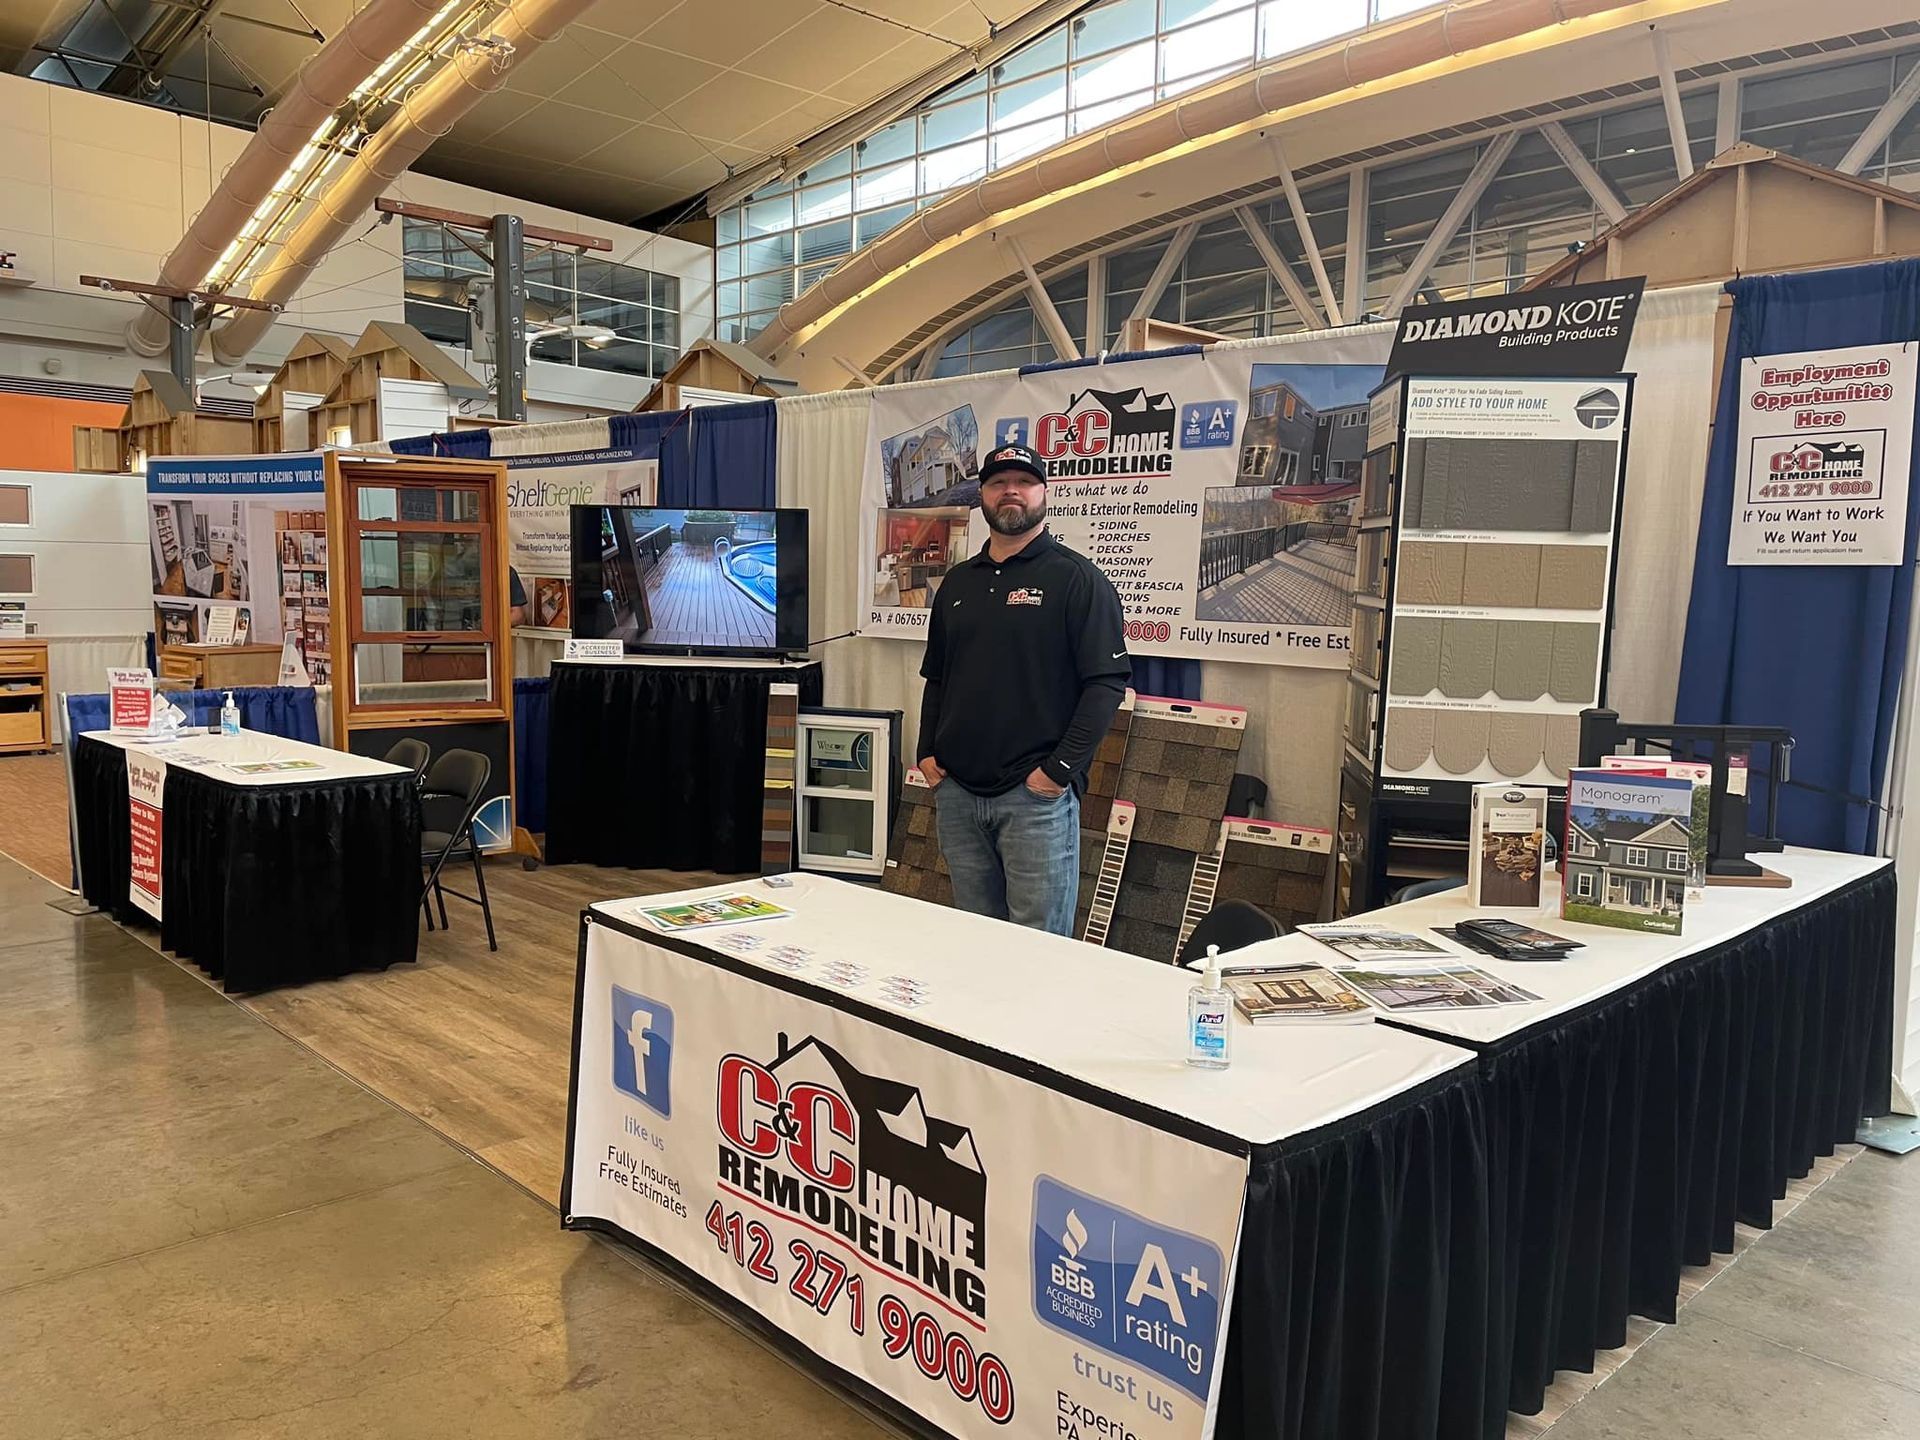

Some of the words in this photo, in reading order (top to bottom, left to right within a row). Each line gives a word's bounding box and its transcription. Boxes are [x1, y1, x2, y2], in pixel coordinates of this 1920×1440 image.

[1402, 305, 1552, 343] DIAMOND
[1556, 295, 1625, 326] KOTE
[1499, 332, 1551, 348] Building
[1555, 325, 1618, 342] Products
[1761, 359, 1890, 387] Employment
[1411, 397, 1433, 407] ADD
[1436, 397, 1466, 408] STYLE
[1470, 398, 1482, 408] TO
[1486, 398, 1514, 409] YOUR
[1517, 398, 1548, 409] HOME
[1751, 383, 1892, 411] Oppurtunities
[1208, 407, 1232, 430] A+
[1795, 410, 1845, 429] Here
[1035, 409, 1109, 460] C&C
[1113, 431, 1170, 453] HOME
[1207, 431, 1230, 440] rating
[1044, 454, 1172, 476] EMODELING
[1770, 450, 1822, 473] C&C
[1824, 459, 1861, 470] HOME
[158, 472, 190, 484] TRANSFORM
[191, 472, 207, 484] YOUR
[208, 472, 230, 484] SPACES
[231, 471, 257, 483] WITHOUT
[260, 471, 293, 483] REPLACING
[294, 470, 313, 482] YOUR
[1769, 469, 1863, 481] REMODELING
[507, 479, 593, 507] ShelfGenie
[1054, 484, 1071, 498] It's
[1076, 482, 1106, 497] what
[1111, 485, 1129, 496] we
[1133, 480, 1149, 495] do
[1759, 484, 1790, 498] 412
[1793, 483, 1824, 497] 271
[1829, 480, 1873, 496] 9000
[1047, 502, 1078, 517] nterior
[1081, 502, 1088, 515] &
[1090, 501, 1131, 516] Exterior
[1133, 500, 1198, 516] Remodeling
[1743, 510, 1752, 523] If
[1758, 509, 1780, 522] You
[1787, 508, 1822, 521] Want
[1827, 508, 1840, 520] to
[1847, 506, 1884, 520] Work
[1098, 521, 1138, 530] SIDING
[1764, 531, 1785, 543] We
[1792, 530, 1826, 543] Want
[1832, 529, 1857, 542] You
[1097, 533, 1150, 542] PORCHES
[1096, 545, 1133, 554] DECKS
[1095, 557, 1153, 566] MASONRY
[1103, 569, 1147, 578] OOFING
[872, 611, 882, 624] PA
[887, 612, 894, 624] #
[895, 612, 928, 627] 067657
[1135, 606, 1142, 614] &
[1146, 606, 1181, 616] MORE
[1180, 626, 1213, 645] Fully
[1217, 628, 1269, 646] Insured
[1287, 631, 1321, 648] Free
[1581, 786, 1661, 805] Monogram
[624, 1115, 648, 1141] like
[651, 1133, 665, 1151] us
[717, 1053, 856, 1192] C&C
[866, 1169, 976, 1261] HOME
[608, 1145, 638, 1175] Fully
[641, 1159, 681, 1195] Insured
[600, 1162, 628, 1186] Free
[632, 1175, 687, 1219] Estimates
[718, 1144, 986, 1320] REMODELING
[1051, 1263, 1096, 1300] BBB
[1125, 1242, 1208, 1328] A+
[705, 1199, 779, 1284] 412
[788, 1239, 865, 1336] 271
[878, 1294, 1016, 1426] 9000
[1046, 1286, 1103, 1319] ACCREDITED
[1052, 1300, 1096, 1329] BUSINESS
[1125, 1313, 1203, 1375] rating
[1073, 1352, 1137, 1401] trust
[1147, 1390, 1174, 1422] us
[1057, 1390, 1141, 1440] Experie
